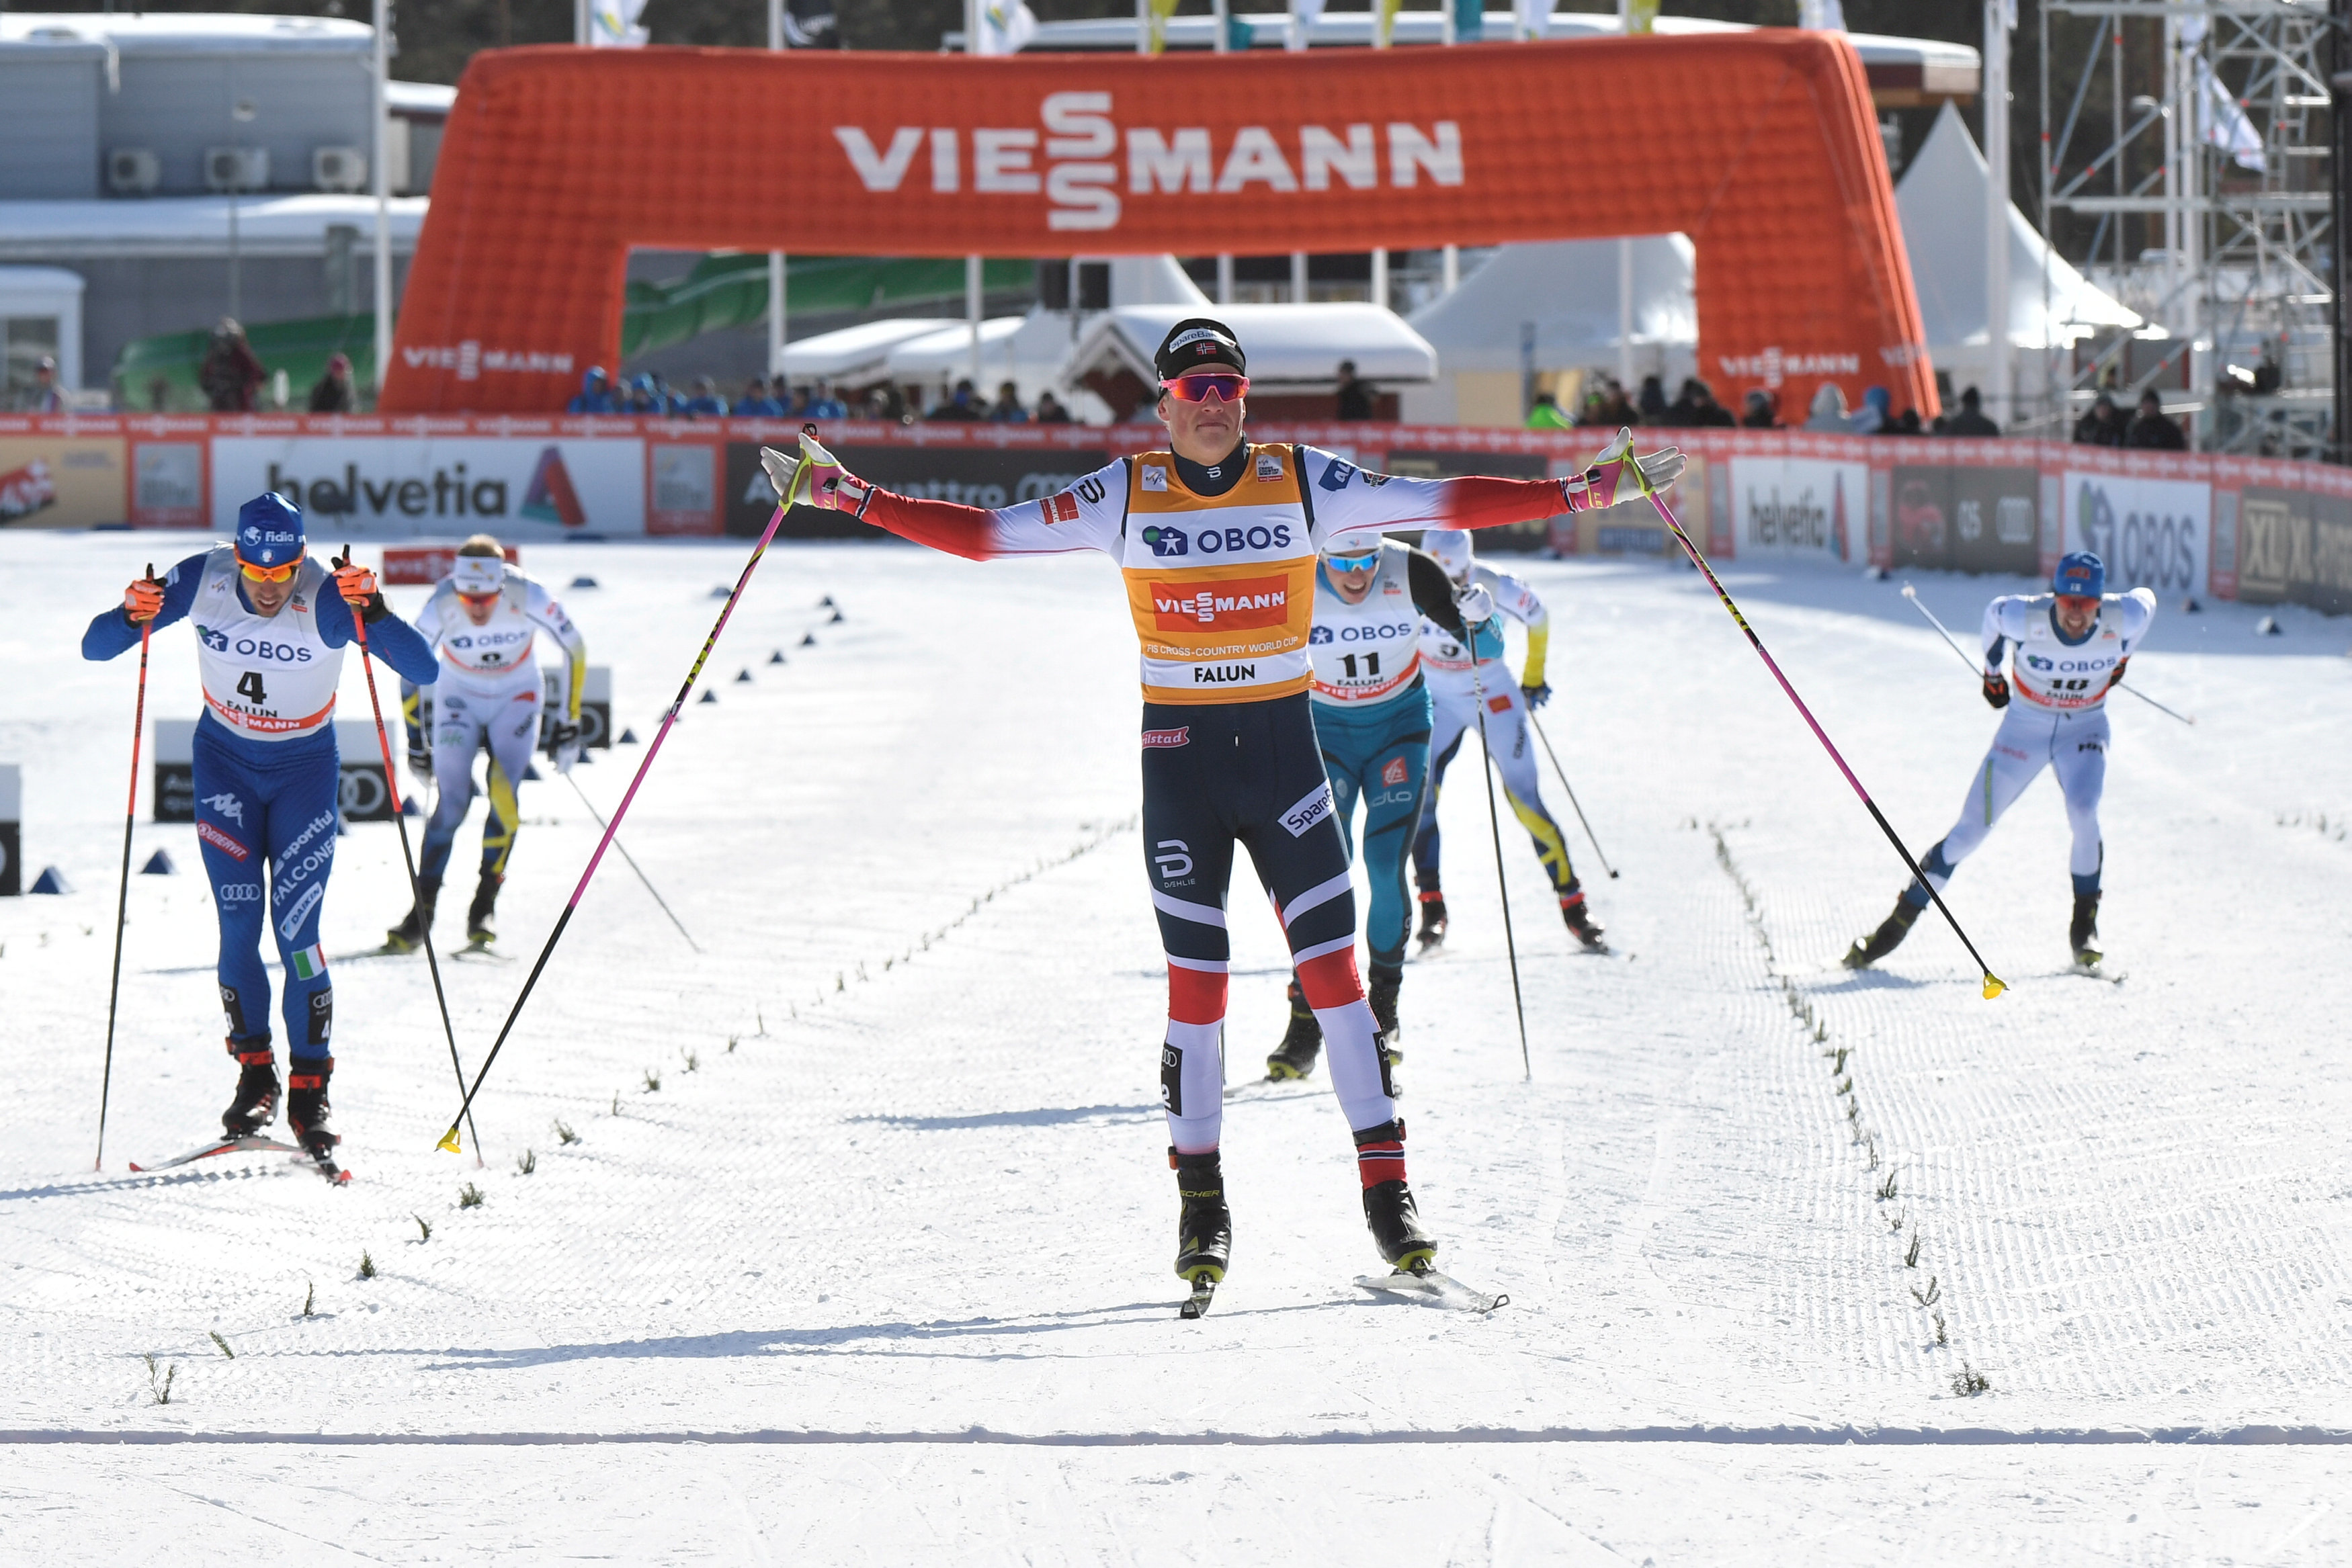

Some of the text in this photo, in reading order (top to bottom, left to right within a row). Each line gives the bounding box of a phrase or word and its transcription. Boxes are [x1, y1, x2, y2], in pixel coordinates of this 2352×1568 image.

[833, 90, 1464, 231] VIESSMANN
[403, 339, 573, 380] VIESSMANN
[1718, 346, 1859, 388] VIESSMANN
[266, 462, 507, 517] helvetia
[265, 531, 294, 542] fidia
[1197, 525, 1292, 554] OBOS
[2124, 511, 2195, 589] OBOS
[1155, 591, 1285, 622] VIESSMANN
[1146, 636, 1298, 657] FIS CROSS-COUNTRY WORLD CUP
[1341, 623, 1411, 641] OBOS
[236, 639, 312, 662] OBOS
[1336, 652, 1380, 677] 11
[237, 670, 267, 705] 4
[1193, 664, 1255, 683] FALUN
[1337, 676, 1384, 687] FALUN
[226, 699, 278, 718] FALUN
[206, 829, 248, 858] ENERVIT
[282, 809, 335, 861] sportful
[290, 884, 321, 925] DAIKIN
